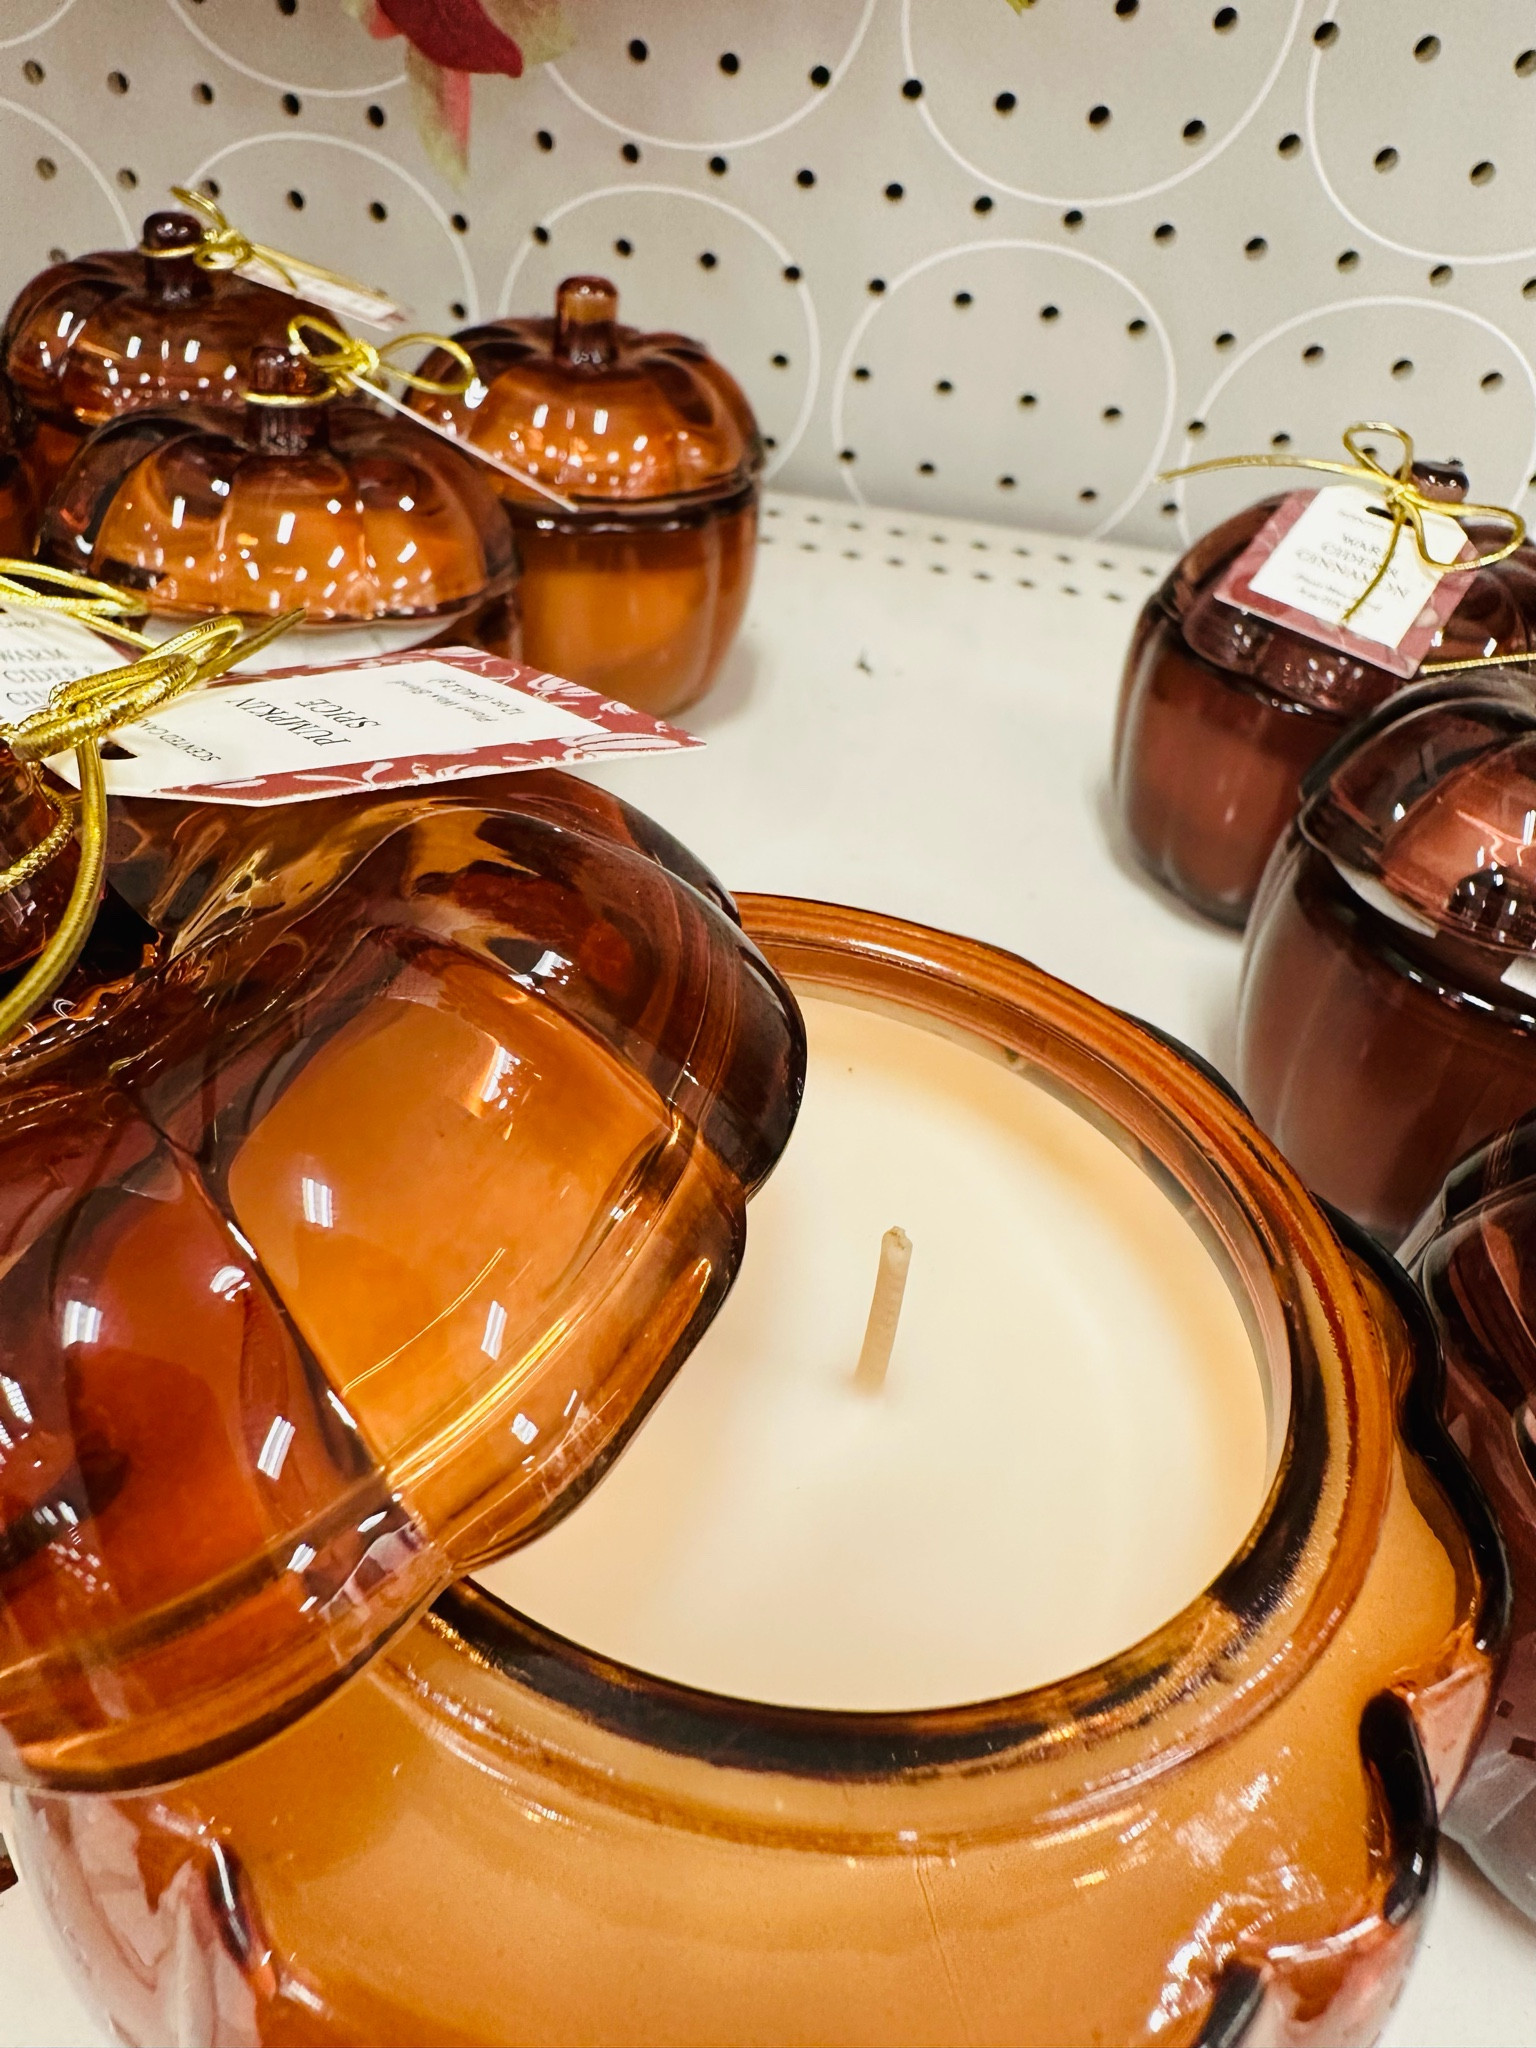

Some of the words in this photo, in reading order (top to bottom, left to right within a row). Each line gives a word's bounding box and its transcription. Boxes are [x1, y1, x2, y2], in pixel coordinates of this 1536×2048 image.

[1342, 533, 1395, 559] WAR
[225, 697, 352, 747] PUMPKIN
[295, 698, 382, 729] SPICE
[160, 734, 222, 762] SCENTED
